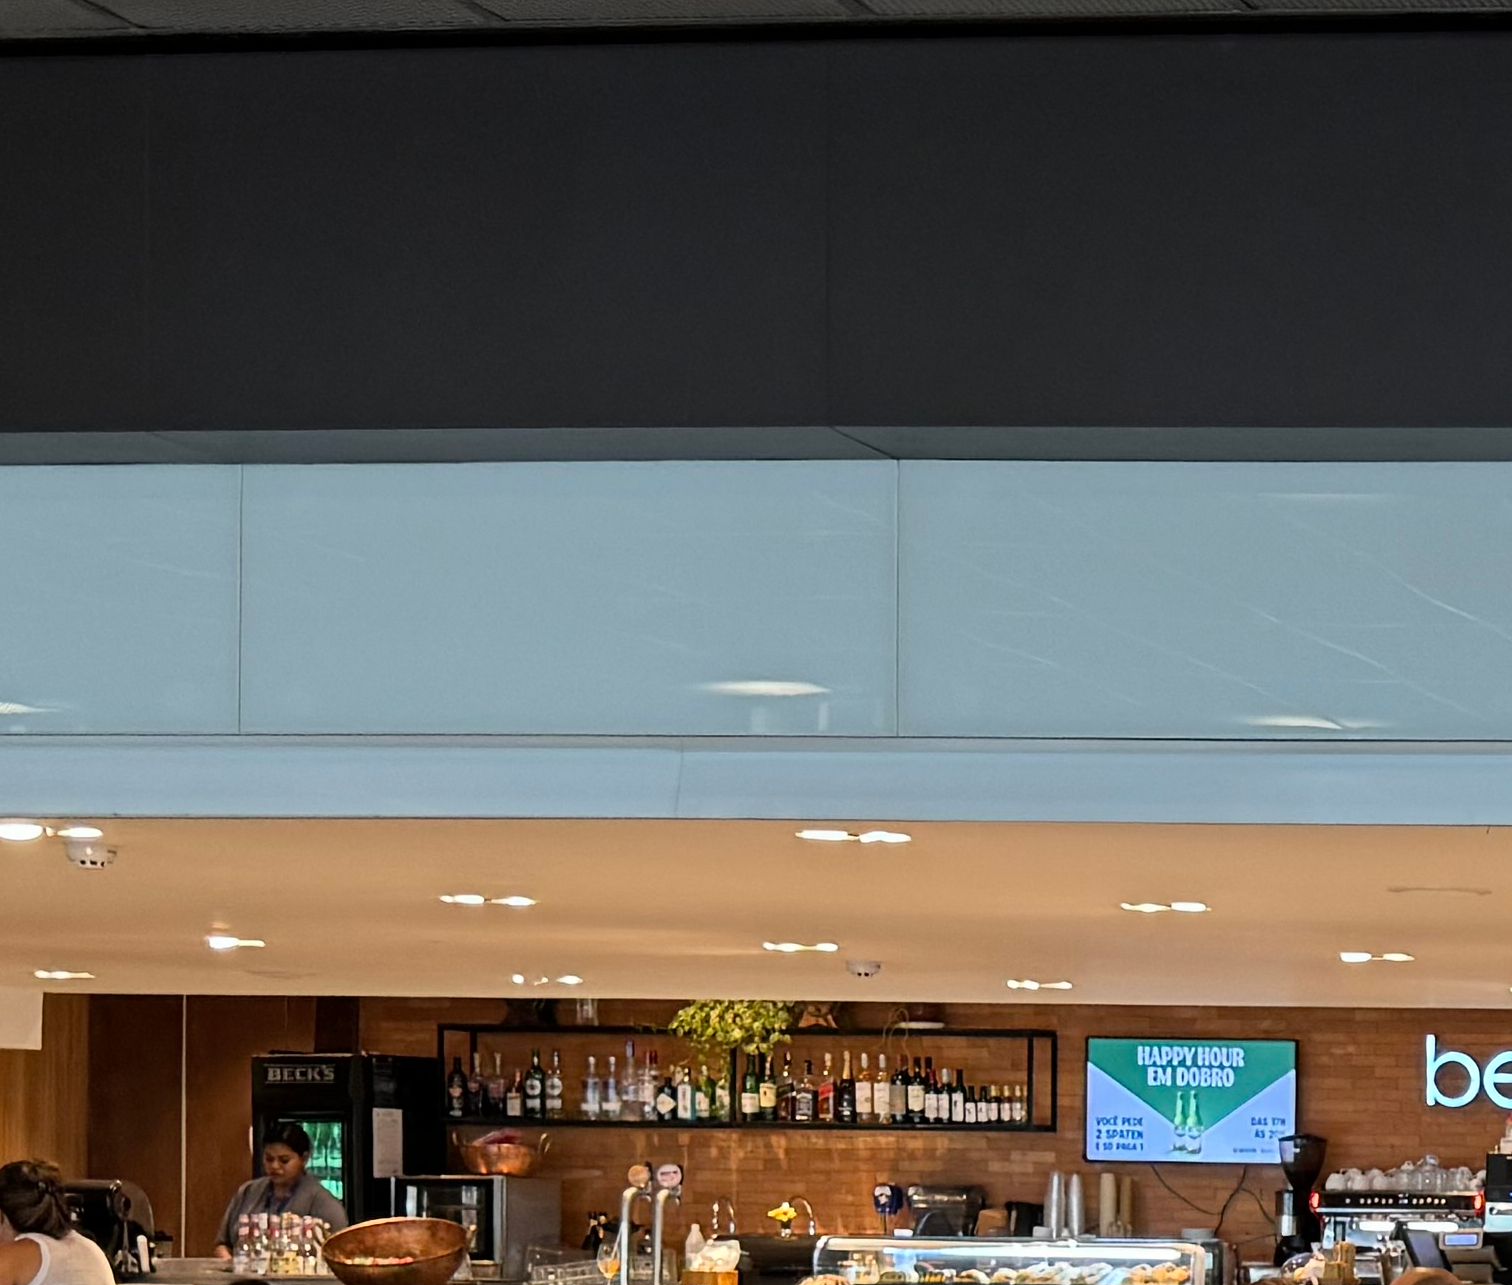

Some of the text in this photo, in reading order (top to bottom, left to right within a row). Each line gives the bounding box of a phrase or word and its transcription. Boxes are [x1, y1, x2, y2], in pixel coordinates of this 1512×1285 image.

[1137, 1045, 1245, 1068] HAPPY HOUR
[267, 1065, 335, 1082] BECK'S
[1147, 1066, 1235, 1088] EM DOBRO
